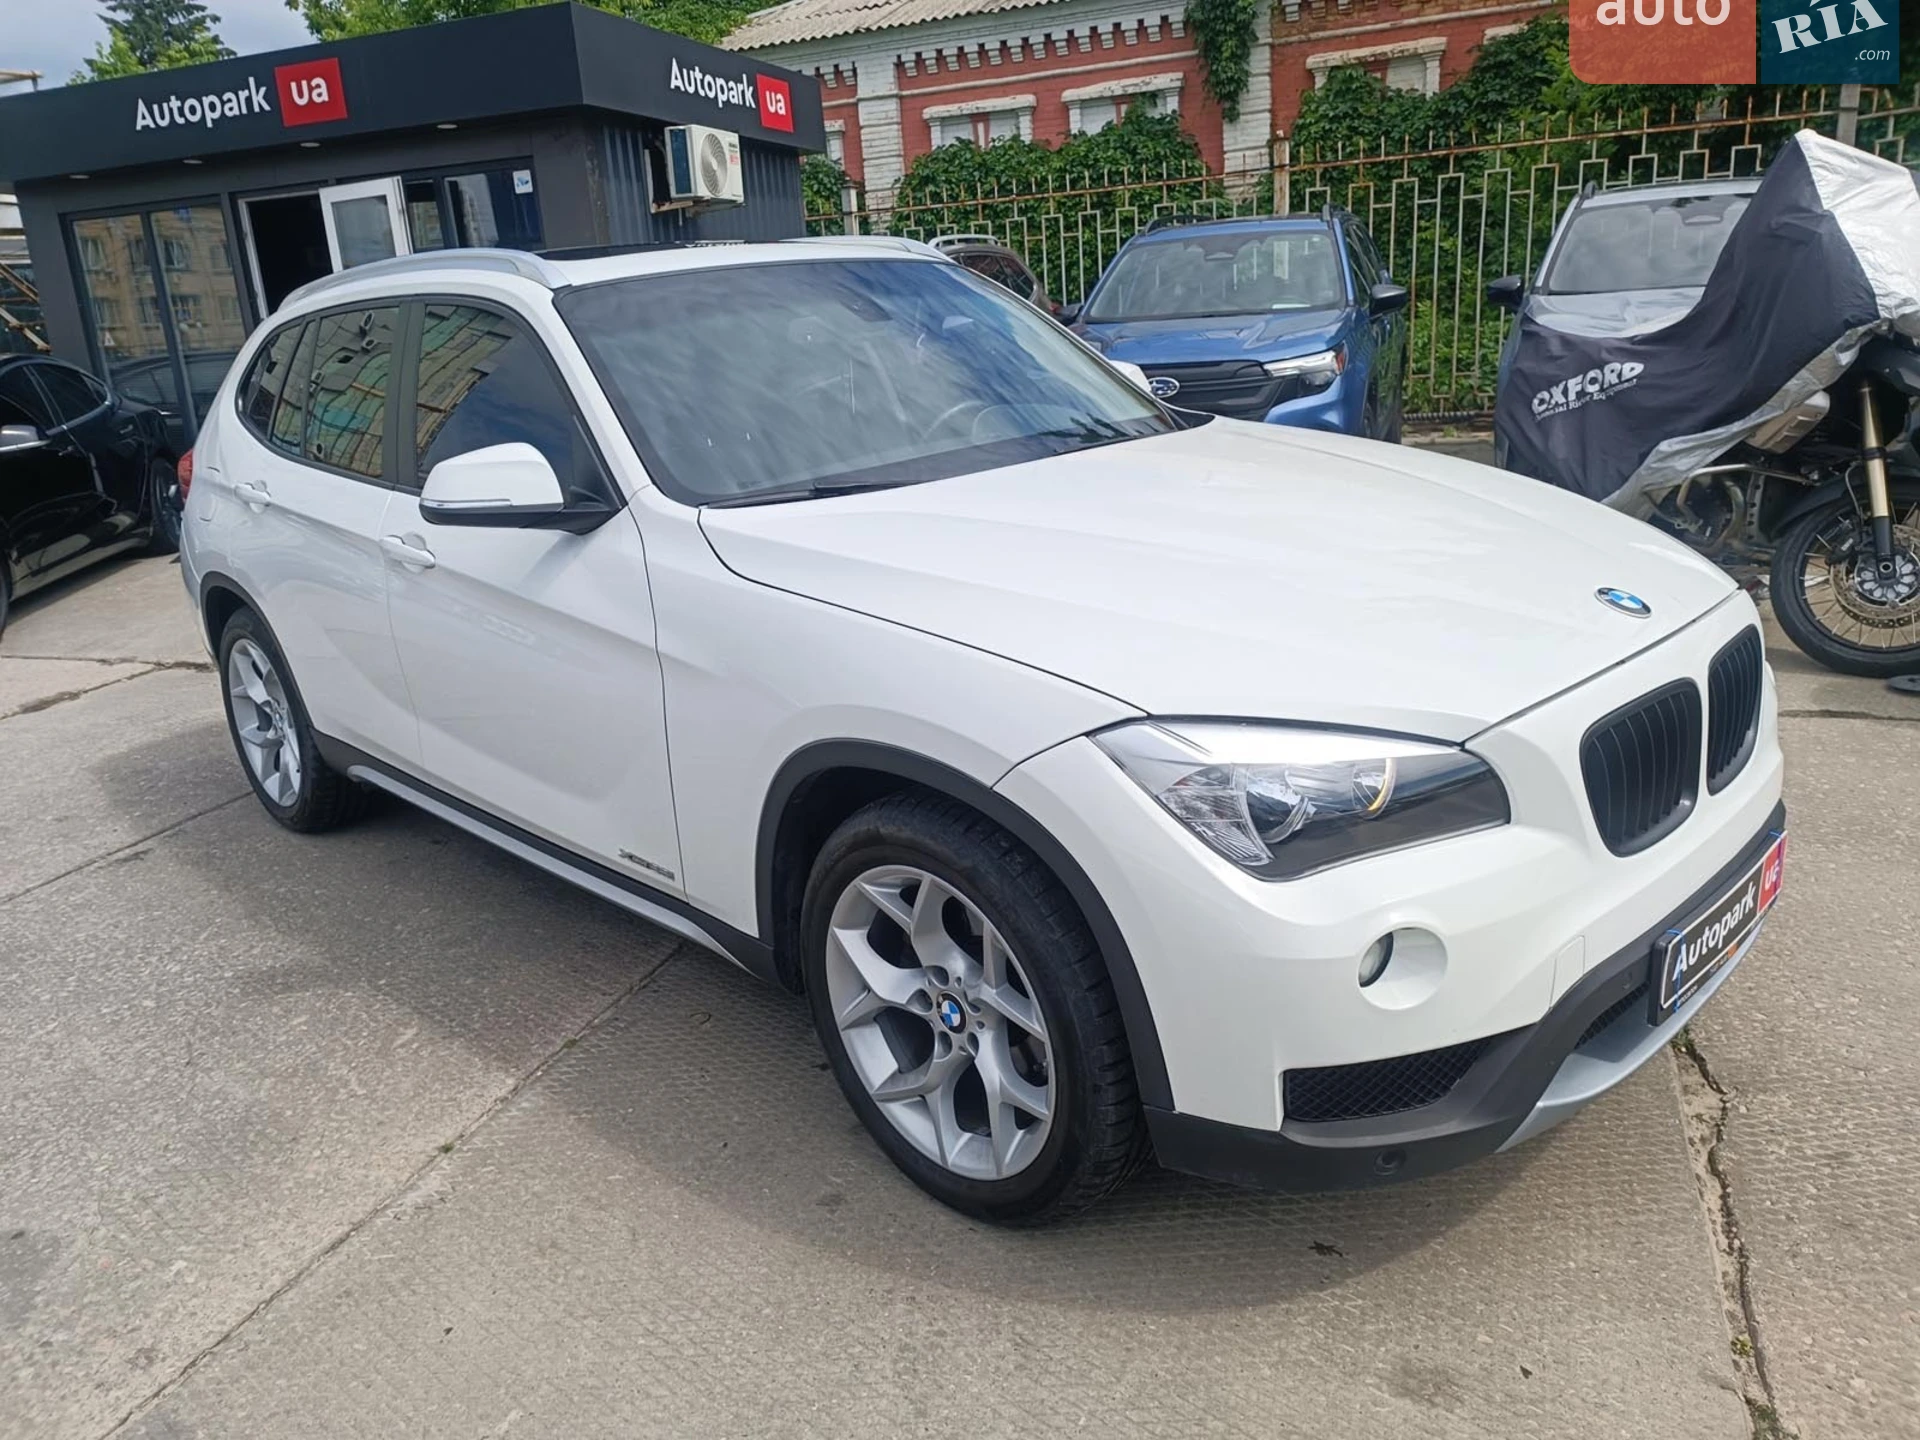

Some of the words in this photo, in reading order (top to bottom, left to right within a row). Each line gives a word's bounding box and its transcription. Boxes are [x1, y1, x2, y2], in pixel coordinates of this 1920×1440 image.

[135, 77, 271, 131] Autopark
[290, 77, 329, 106] ua
[670, 57, 756, 108] Autopark
[766, 90, 786, 116] ua
[1531, 362, 1644, 415] OXFORD
[1672, 882, 1757, 981] Autopark
